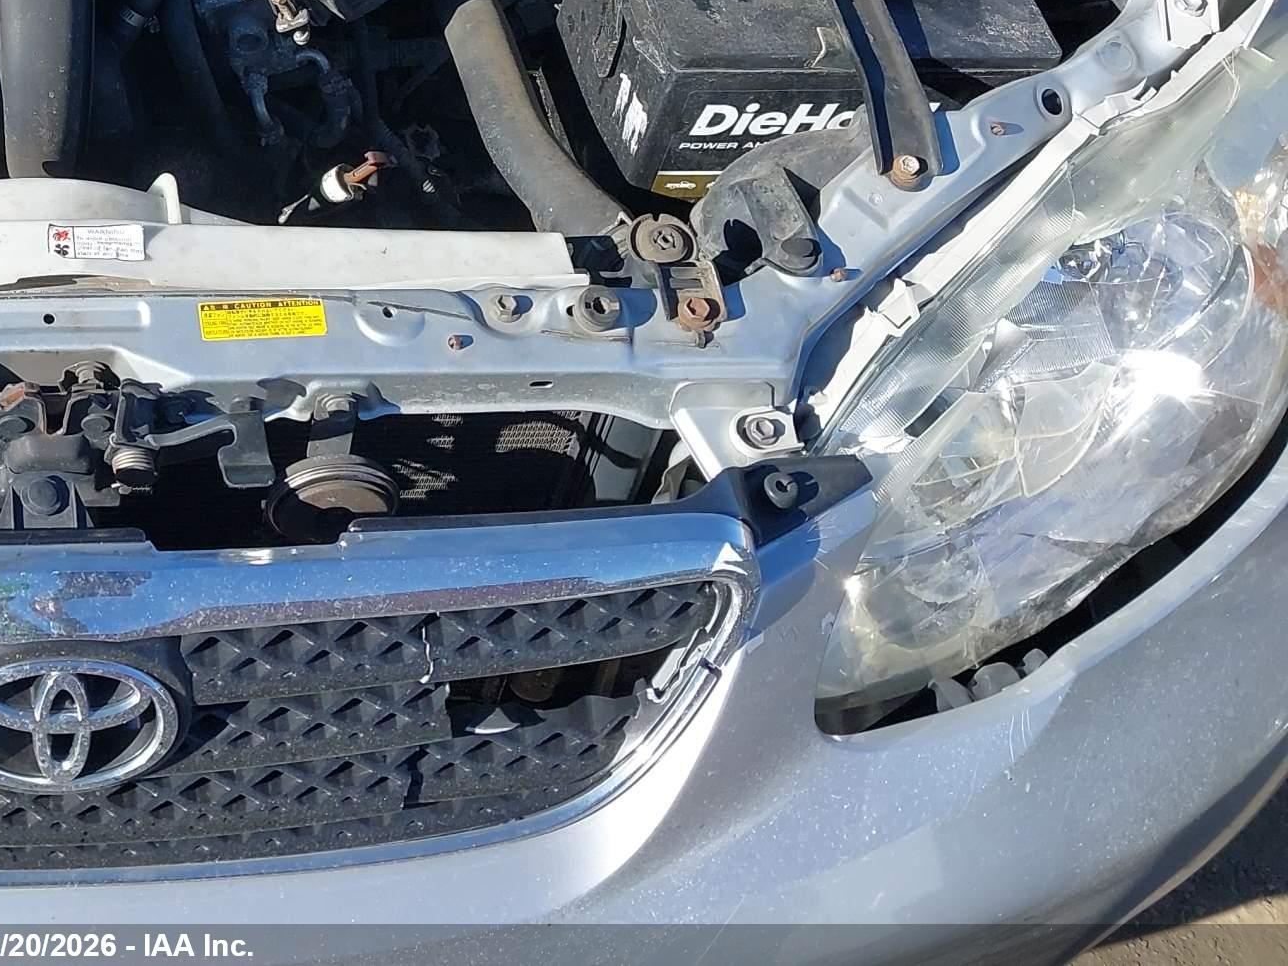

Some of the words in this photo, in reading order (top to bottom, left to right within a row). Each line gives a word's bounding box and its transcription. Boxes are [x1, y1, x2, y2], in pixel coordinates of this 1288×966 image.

[678, 141, 739, 150] POWER
[234, 301, 272, 310] CAUTION
[278, 299, 320, 308] ATTENTION
